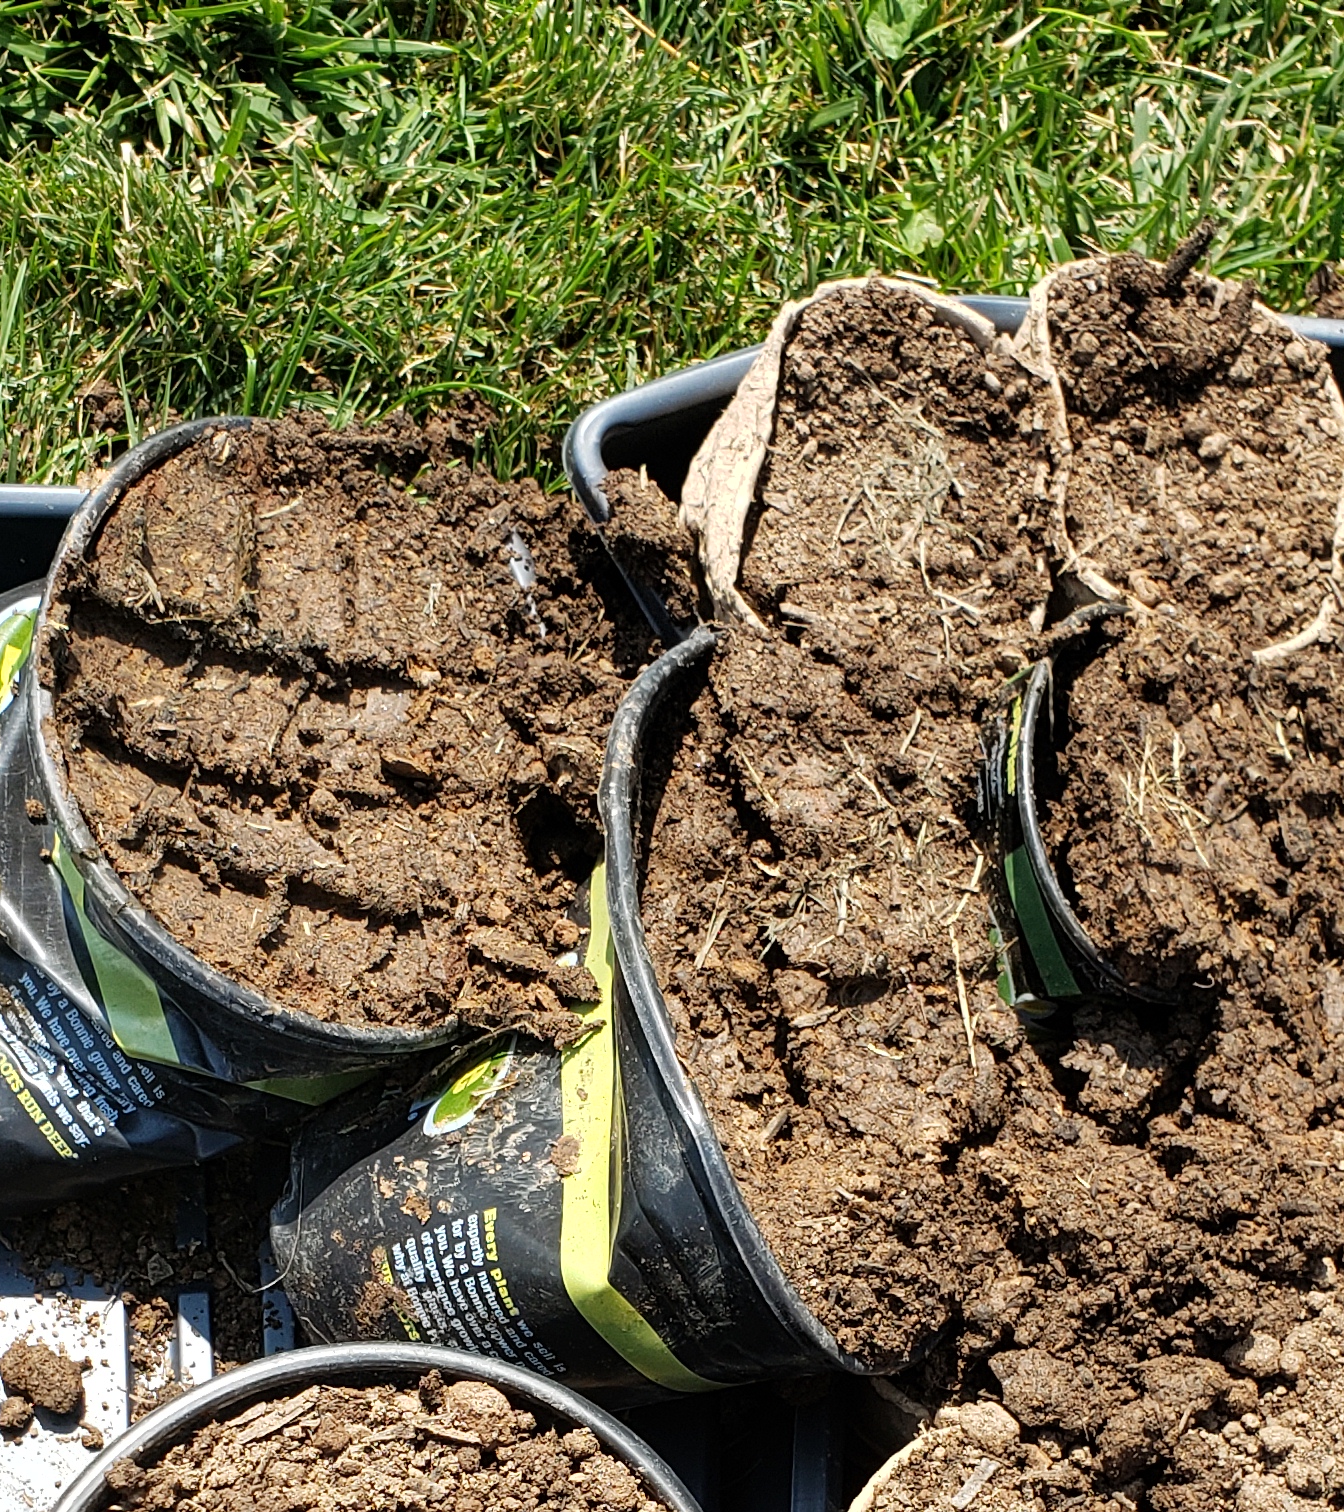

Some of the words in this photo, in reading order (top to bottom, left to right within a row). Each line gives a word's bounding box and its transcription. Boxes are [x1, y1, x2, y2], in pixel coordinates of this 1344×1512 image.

[18, 971, 38, 999] you.
[34, 995, 51, 1018] We
[46, 1016, 69, 1049] have
[62, 1047, 87, 1072] over
[56, 996, 71, 1011] a
[64, 1008, 94, 1049] Bonnie
[87, 1050, 120, 1089] grower
[9, 1039, 38, 1074] Bonnie
[55, 1102, 73, 1125] we
[112, 1050, 132, 1074] and
[127, 1075, 154, 1107] cared
[152, 1084, 165, 1099] is
[16, 1088, 46, 1124] RUN
[55, 1070, 79, 1098] and
[76, 1100, 105, 1136] that's
[420, 1230, 433, 1245] of
[451, 1218, 463, 1238] for
[453, 1240, 466, 1258] by
[482, 1206, 498, 1261] Every
[391, 1242, 406, 1272] why
[399, 1269, 413, 1286] at
[404, 1237, 426, 1282] quality
[459, 1262, 469, 1274] a
[423, 1245, 455, 1316] experience
[433, 1224, 446, 1255] you.
[441, 1253, 454, 1277] We
[448, 1278, 468, 1311] have
[464, 1311, 486, 1338] over
[481, 1340, 491, 1348] a
[462, 1276, 488, 1318] Bonnie
[466, 1213, 484, 1266] expertly
[476, 1270, 509, 1323] nurtured
[504, 1327, 527, 1348] and
[523, 1351, 554, 1379] cared
[489, 1267, 519, 1316] plant
[405, 1286, 431, 1328] Bonnie
[516, 1318, 533, 1337] we
[484, 1321, 517, 1357] grower
[532, 1341, 555, 1360] sell
[552, 1362, 566, 1372] is
